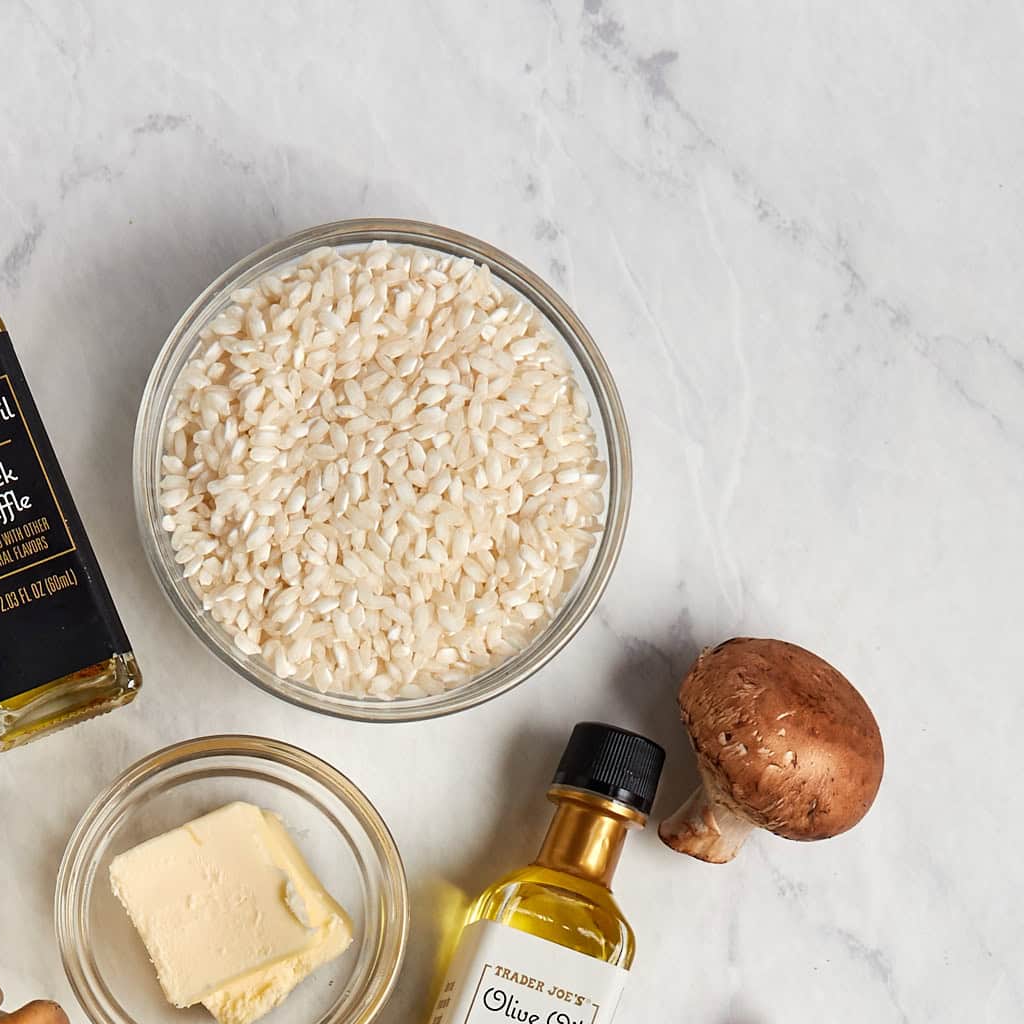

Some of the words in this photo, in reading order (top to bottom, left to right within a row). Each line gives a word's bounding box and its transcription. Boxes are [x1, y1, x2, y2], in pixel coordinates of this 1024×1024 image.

[1, 527, 24, 546] WITH
[23, 517, 50, 538] OTHER
[13, 535, 49, 560] FLAVORS
[18, 586, 32, 604] FL
[31, 581, 46, 599] OZ
[44, 567, 78, 596] (60mL)
[494, 965, 545, 993] TRADER
[547, 986, 586, 1007] JOE'S
